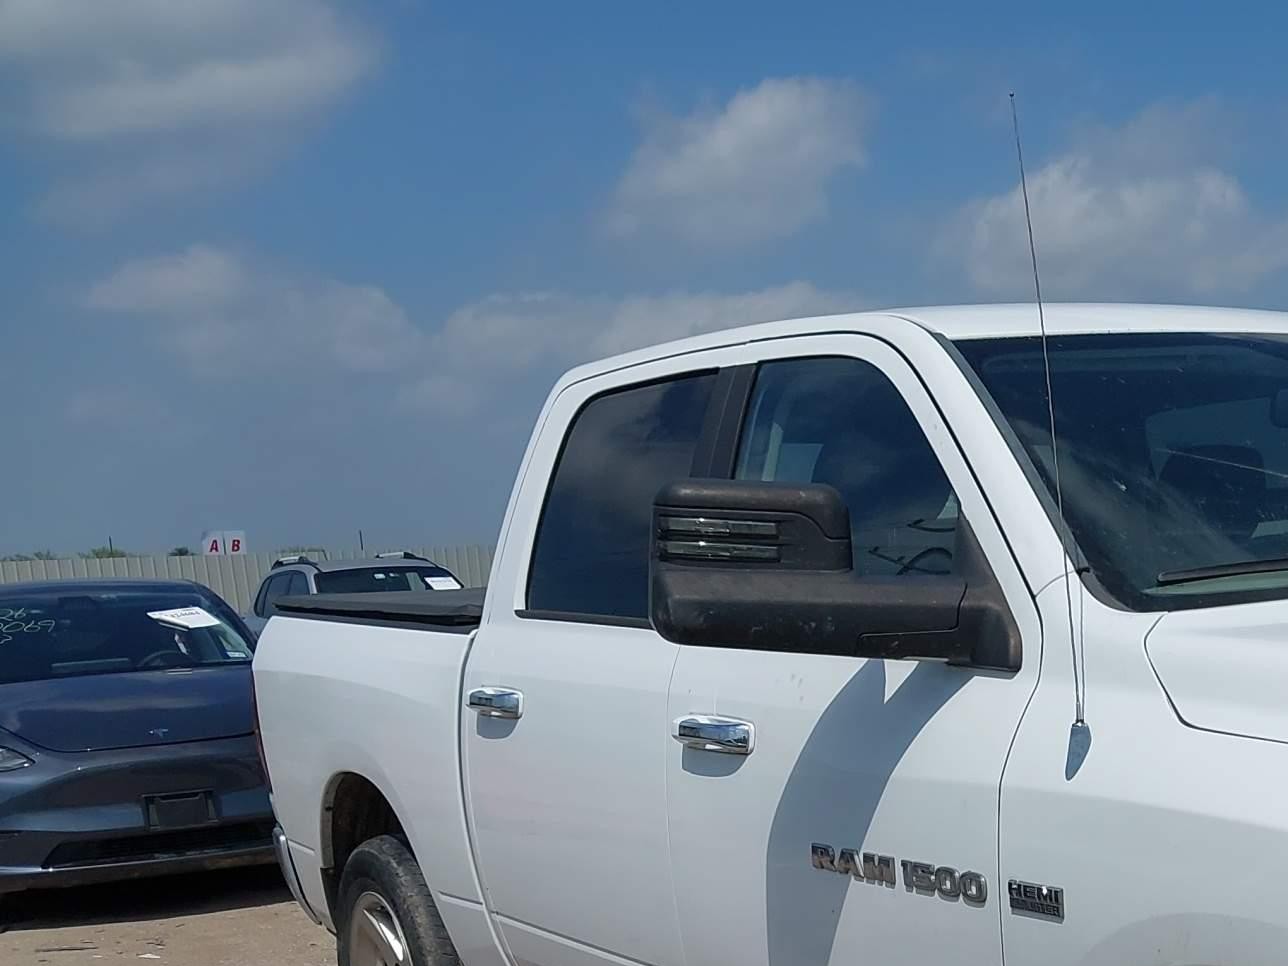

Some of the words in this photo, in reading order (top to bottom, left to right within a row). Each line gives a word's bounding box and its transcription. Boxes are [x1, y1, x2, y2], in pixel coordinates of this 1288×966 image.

[209, 540, 219, 552] A
[231, 540, 241, 552] B
[811, 842, 896, 888] RAM
[901, 860, 988, 907] 1500
[1008, 880, 1063, 903] HEMI
